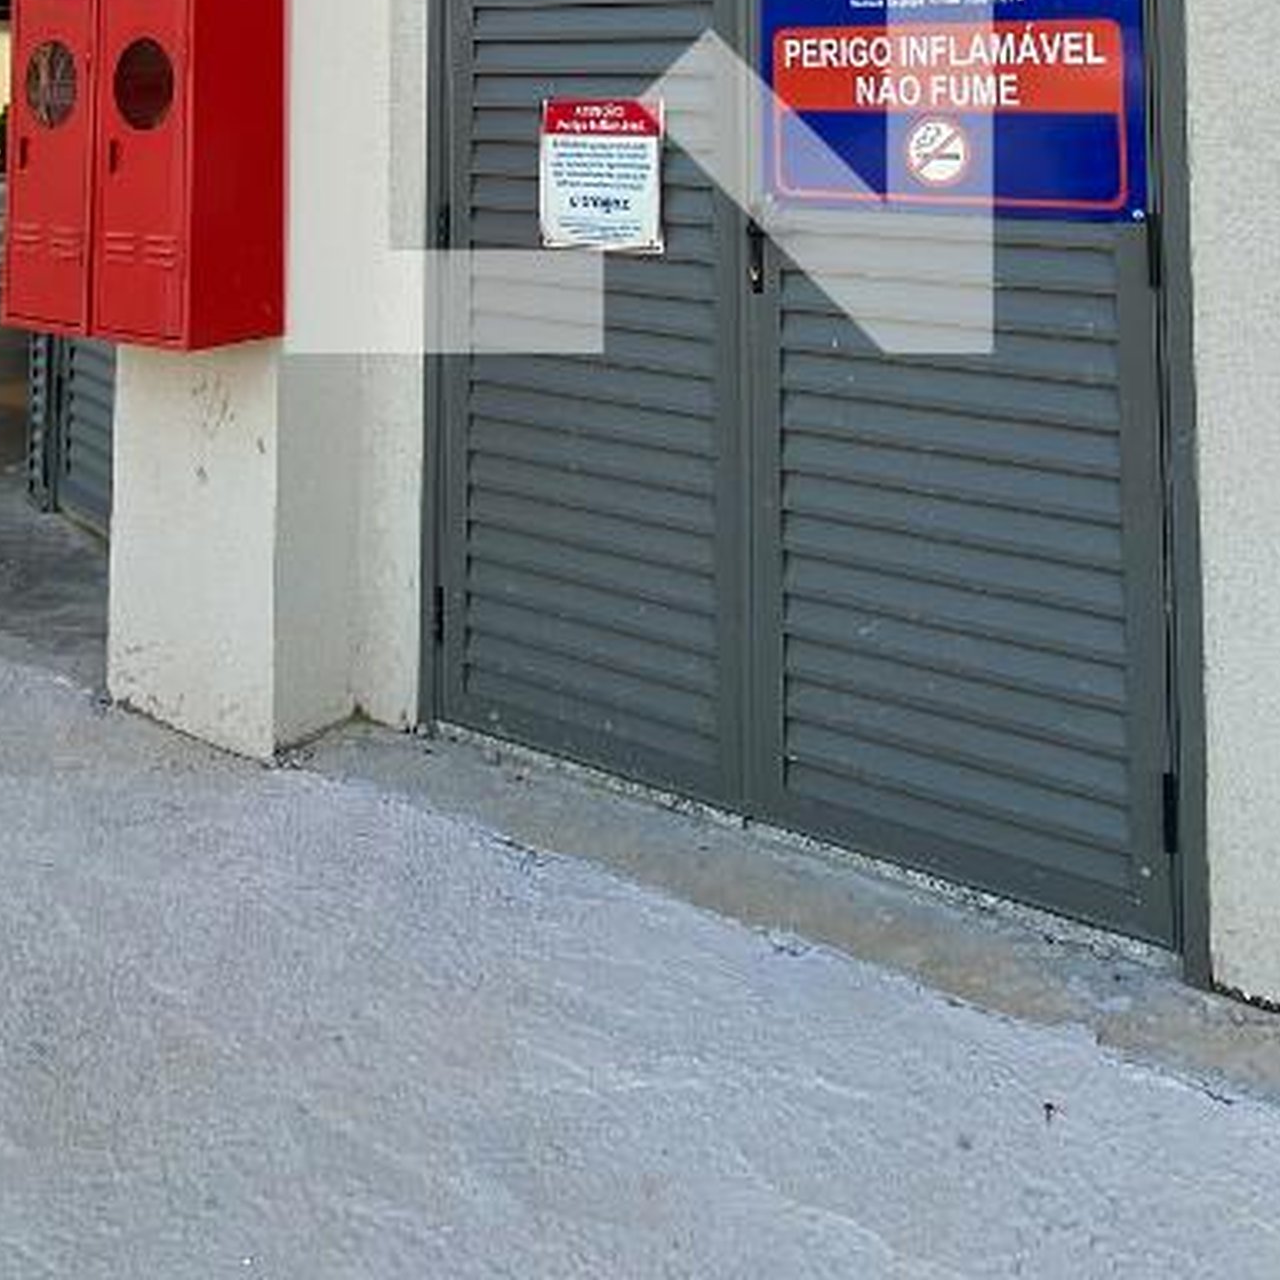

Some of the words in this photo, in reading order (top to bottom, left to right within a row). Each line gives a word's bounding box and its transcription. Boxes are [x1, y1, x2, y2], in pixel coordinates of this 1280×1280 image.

[783, 39, 892, 68] PERIGO
[901, 23, 1107, 66] INFLAMÁVEL
[855, 68, 920, 106] NÃO
[931, 74, 1020, 106] FUME
